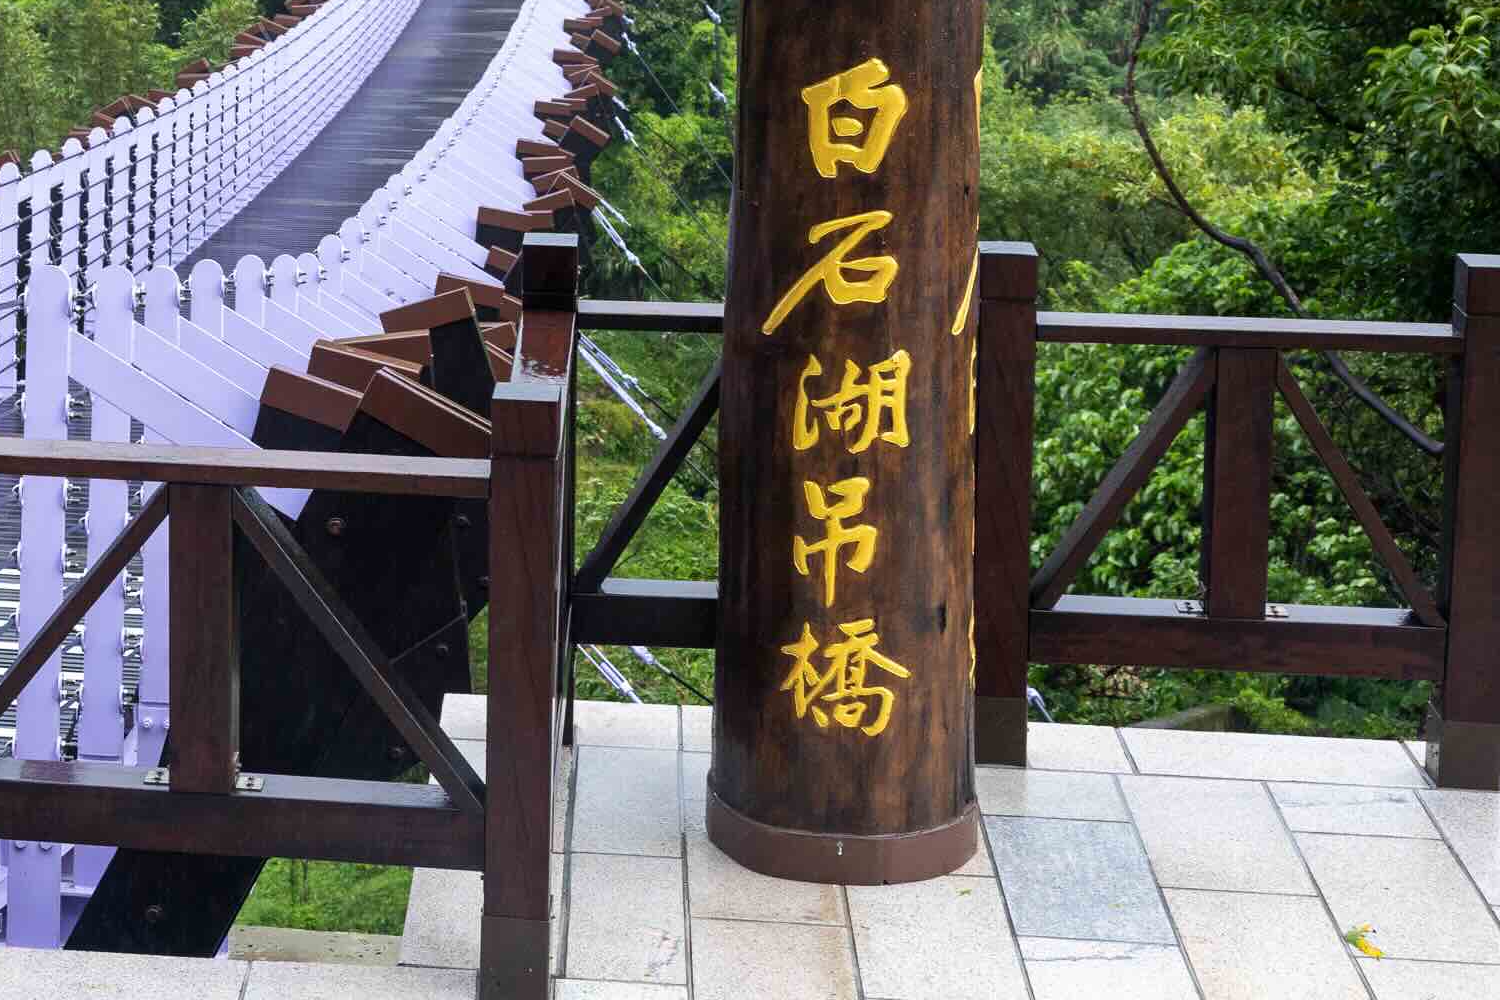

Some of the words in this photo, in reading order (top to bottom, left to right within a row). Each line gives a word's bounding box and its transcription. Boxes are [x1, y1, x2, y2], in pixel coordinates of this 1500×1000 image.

[761, 57, 911, 737] 白石湖吊橋
